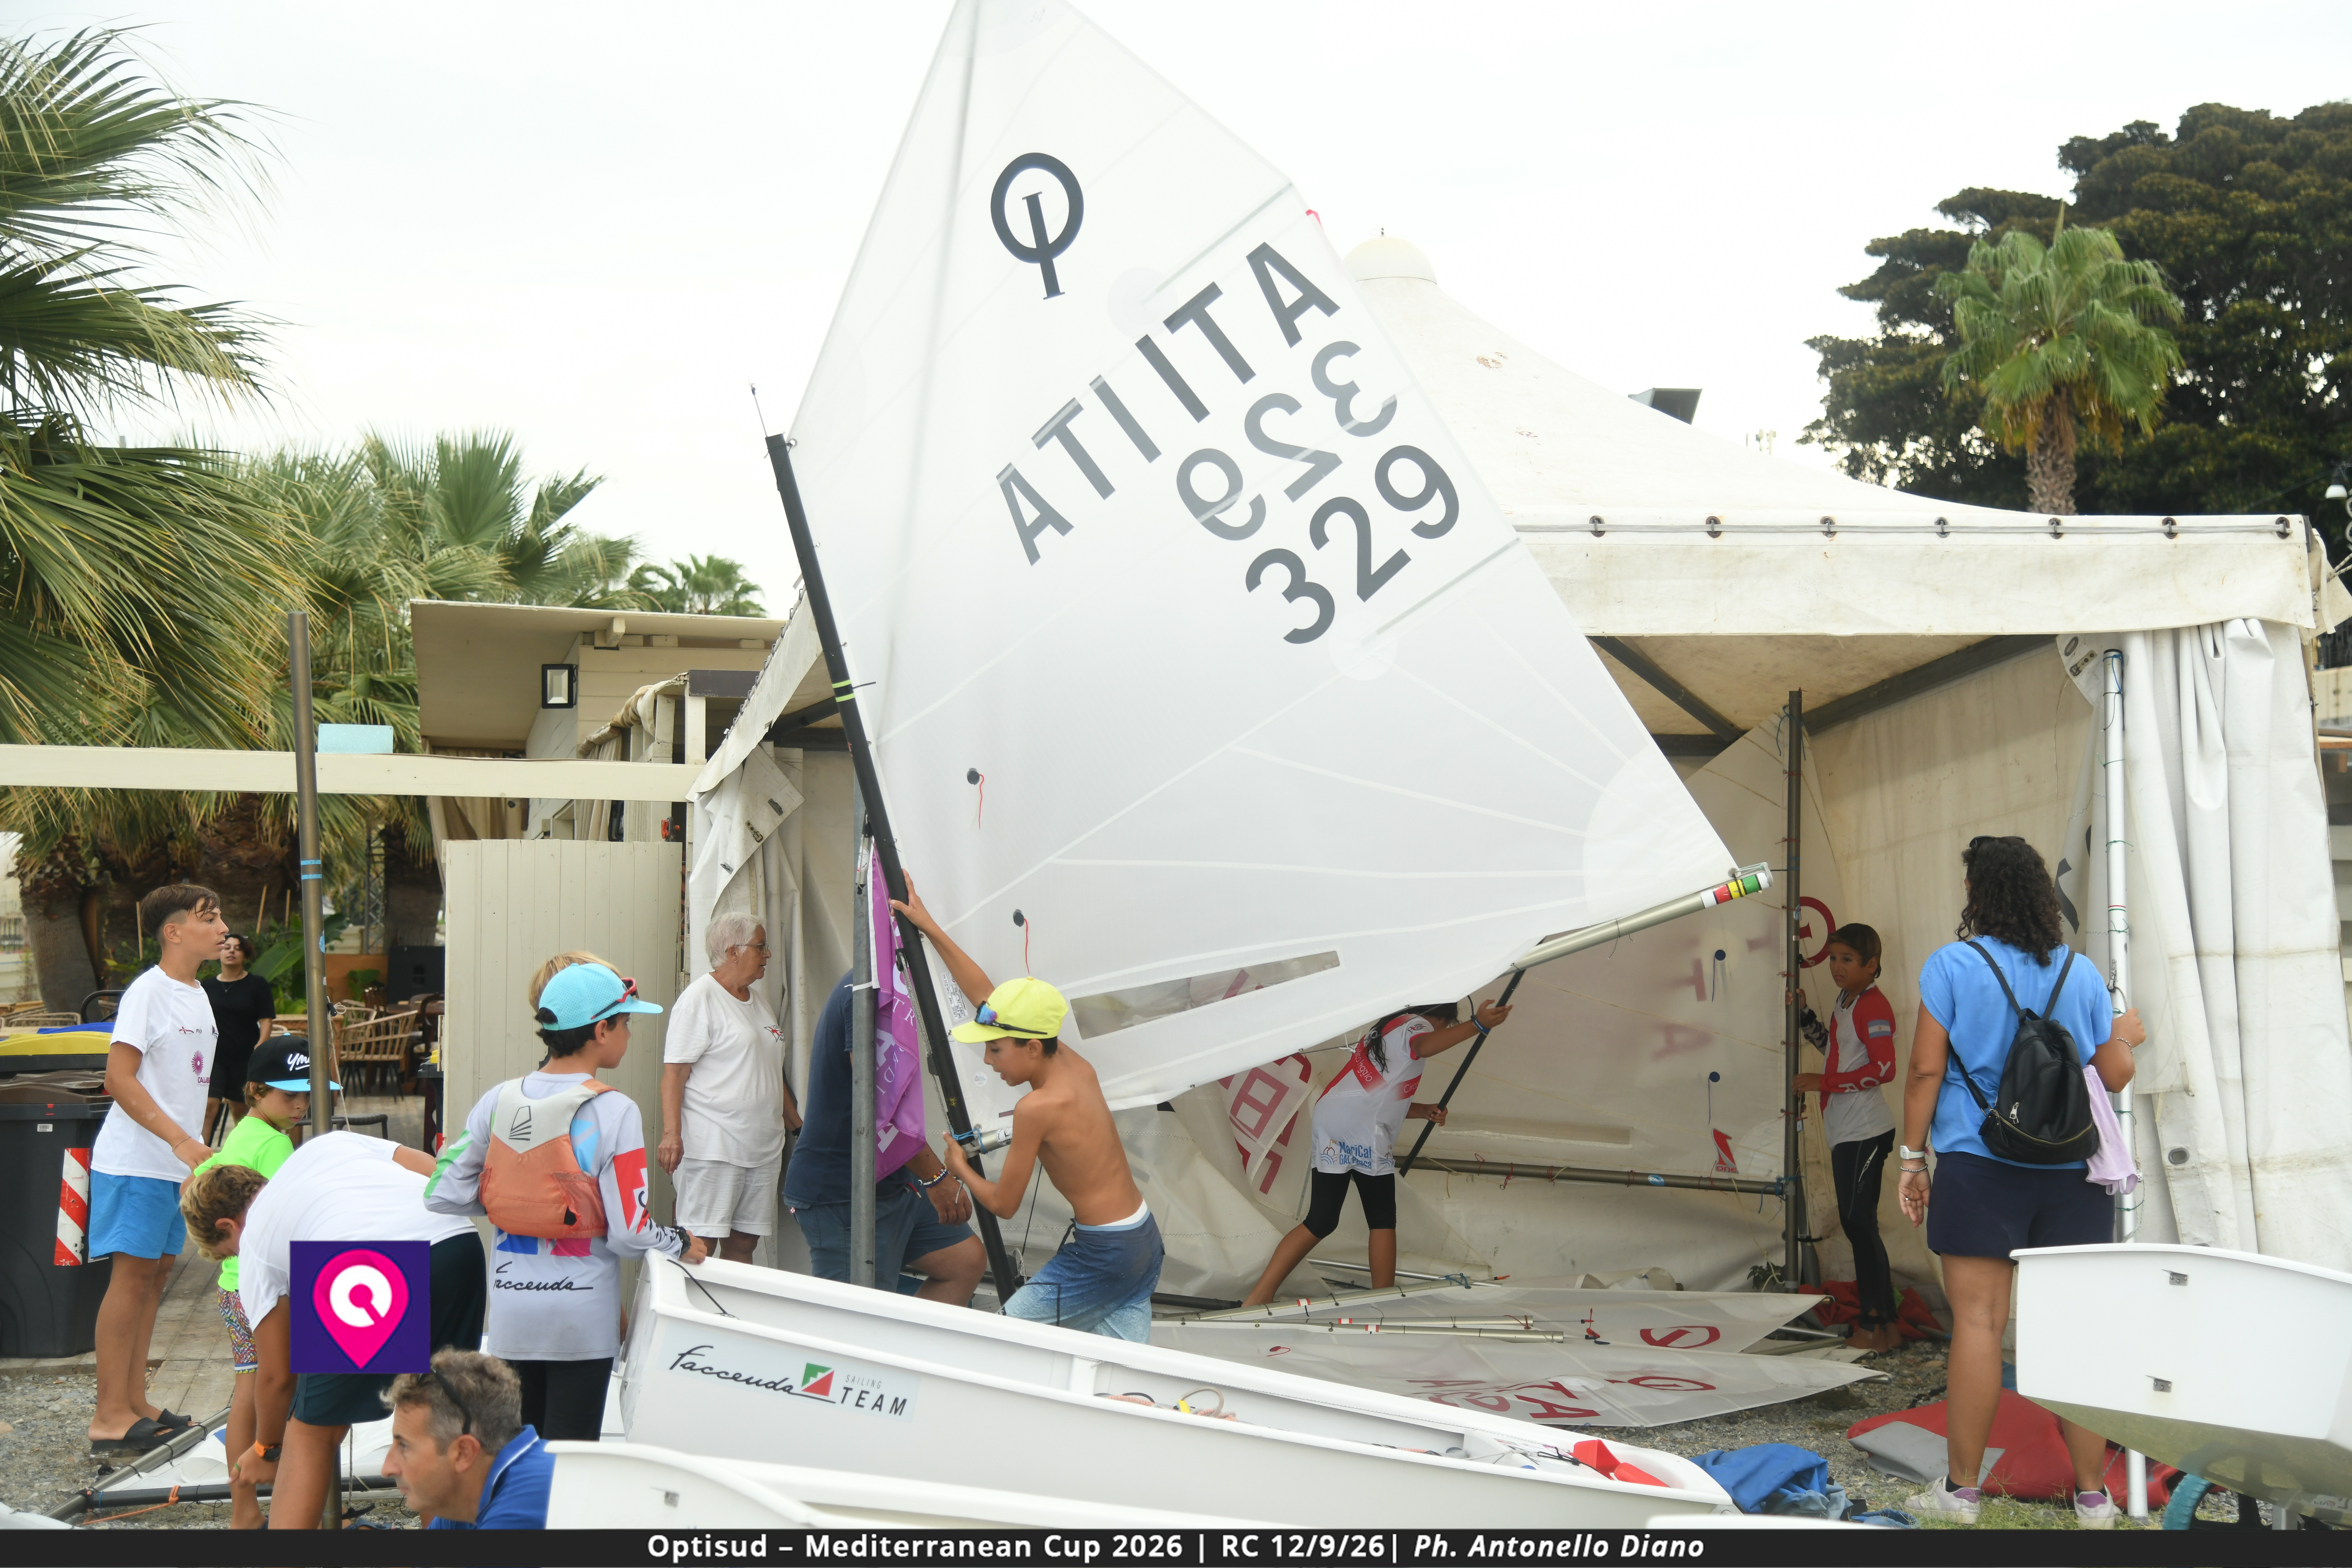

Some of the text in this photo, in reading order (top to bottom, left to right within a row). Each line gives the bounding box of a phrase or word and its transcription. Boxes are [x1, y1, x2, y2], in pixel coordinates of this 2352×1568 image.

[1135, 242, 1341, 424] ITA
[1246, 445, 1459, 645] 329
[1339, 1141, 1372, 1159] MariCal
[846, 1375, 882, 1389] SAILING
[841, 1386, 907, 1416] TEAM
